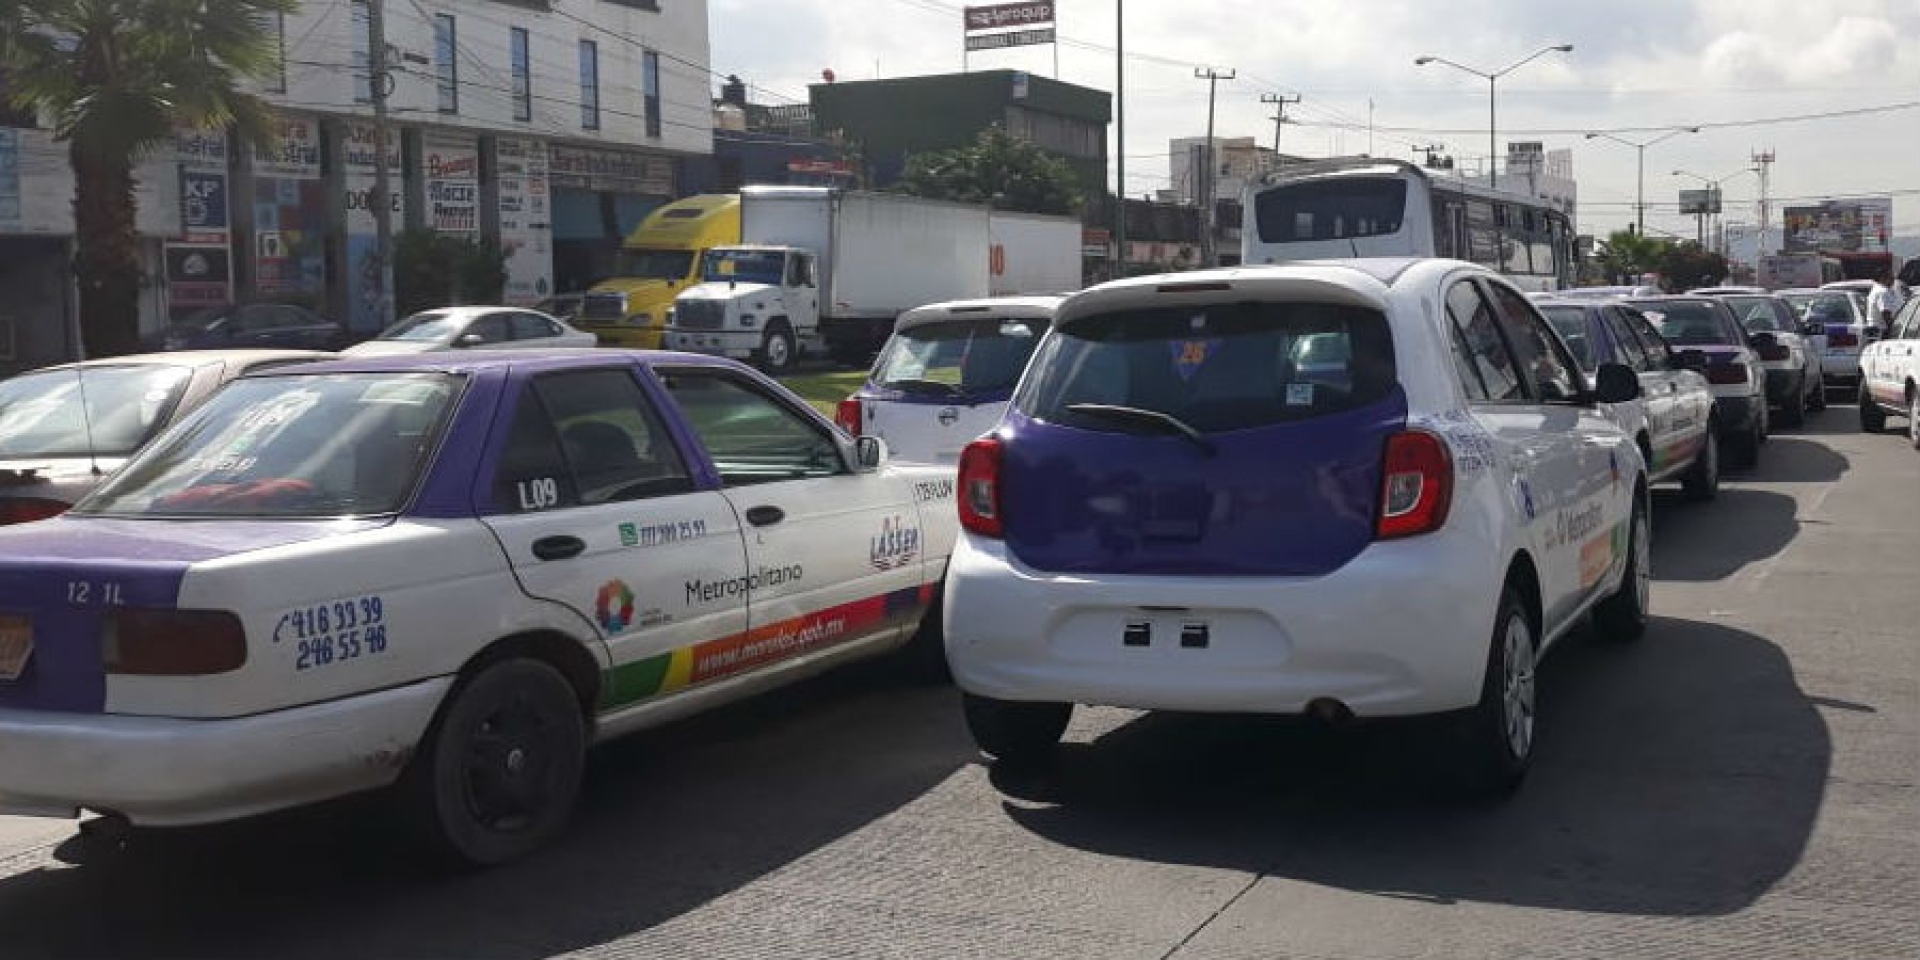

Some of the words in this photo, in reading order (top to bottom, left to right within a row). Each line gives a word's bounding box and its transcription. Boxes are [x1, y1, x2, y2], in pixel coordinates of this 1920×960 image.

[518, 477, 558, 510] L09
[684, 563, 803, 607] Metropolitano
[292, 605, 330, 639] 416
[334, 601, 357, 632] 33
[360, 596, 383, 626] 39
[338, 630, 361, 661] 55
